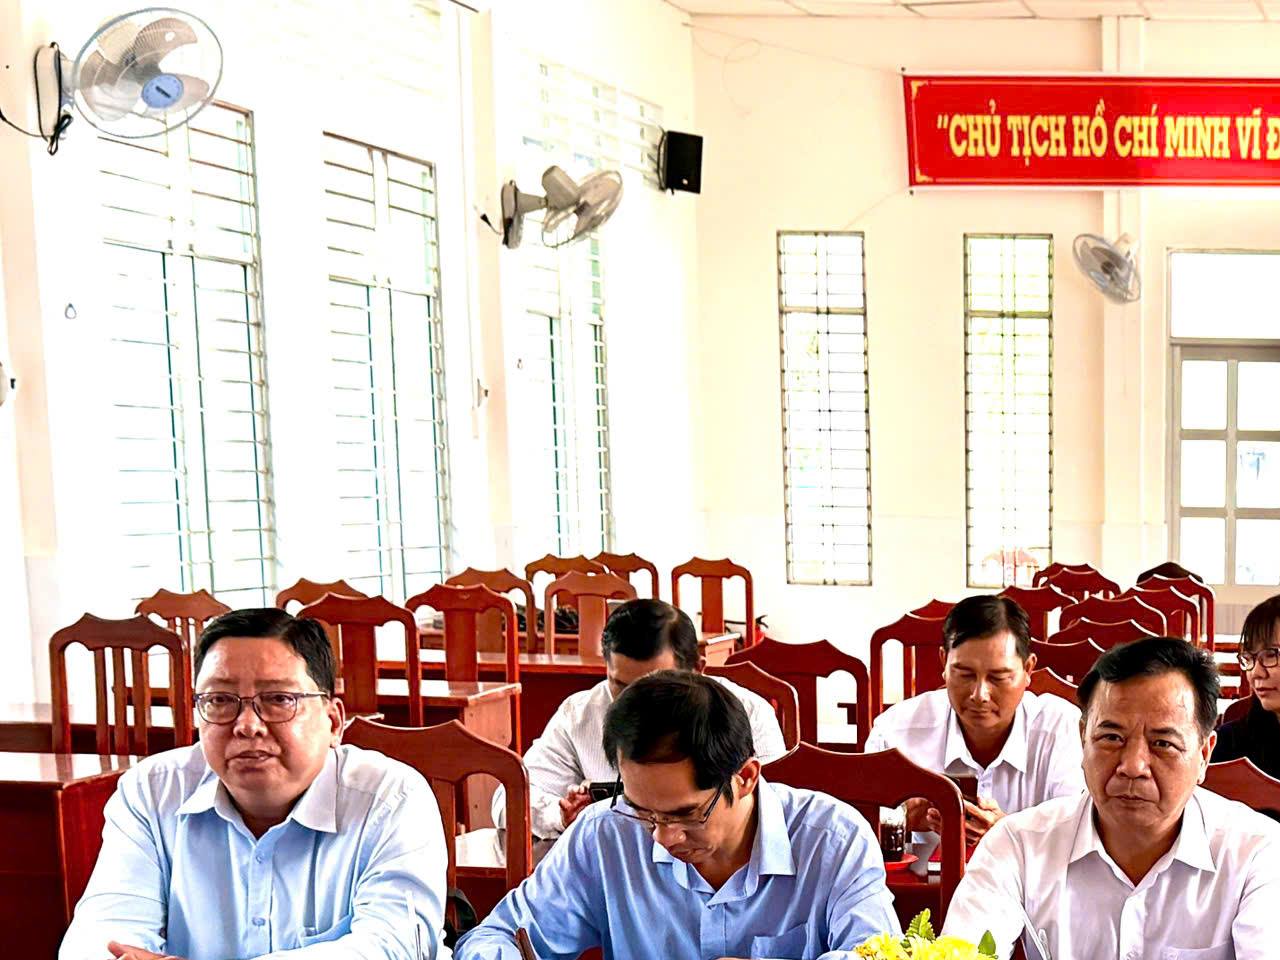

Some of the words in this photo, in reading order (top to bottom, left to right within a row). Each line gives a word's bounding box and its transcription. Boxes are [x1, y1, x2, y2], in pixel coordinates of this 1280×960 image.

[1007, 114, 1067, 166] TỊCH
[1072, 99, 1108, 158] HỒ
[1113, 104, 1159, 158] CHÍ
[1164, 116, 1231, 159] MINH
